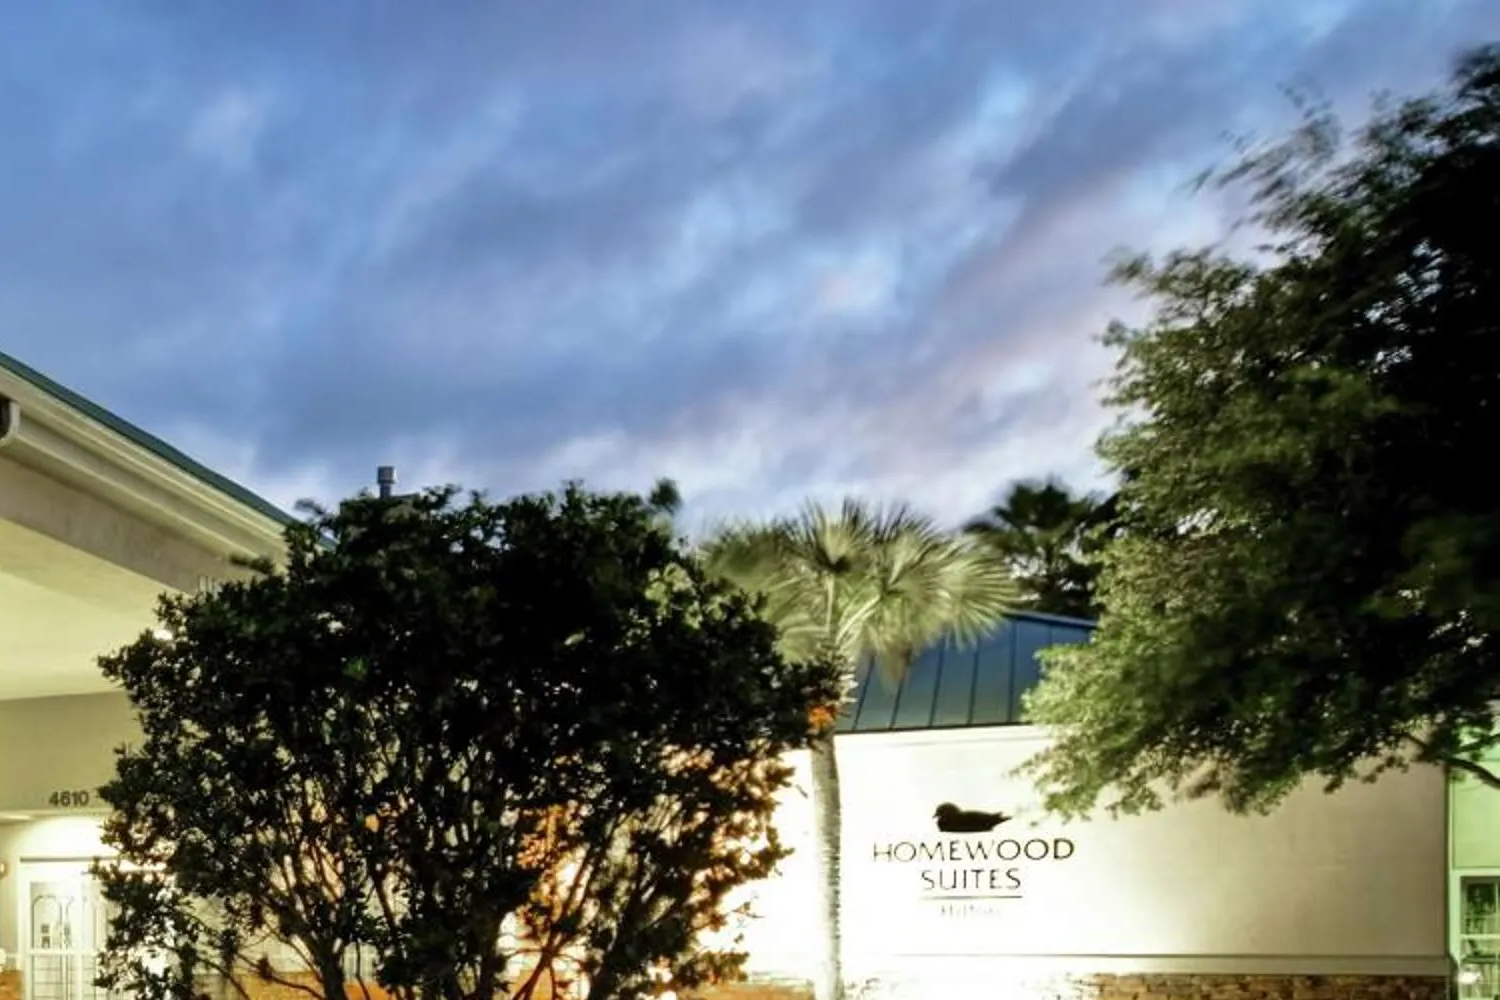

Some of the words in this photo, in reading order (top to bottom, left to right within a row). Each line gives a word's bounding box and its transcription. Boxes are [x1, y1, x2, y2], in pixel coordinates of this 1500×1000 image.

[49, 790, 90, 806] 4610
[873, 838, 1075, 862] HOMEWOOD
[921, 868, 1022, 890] SUITES
